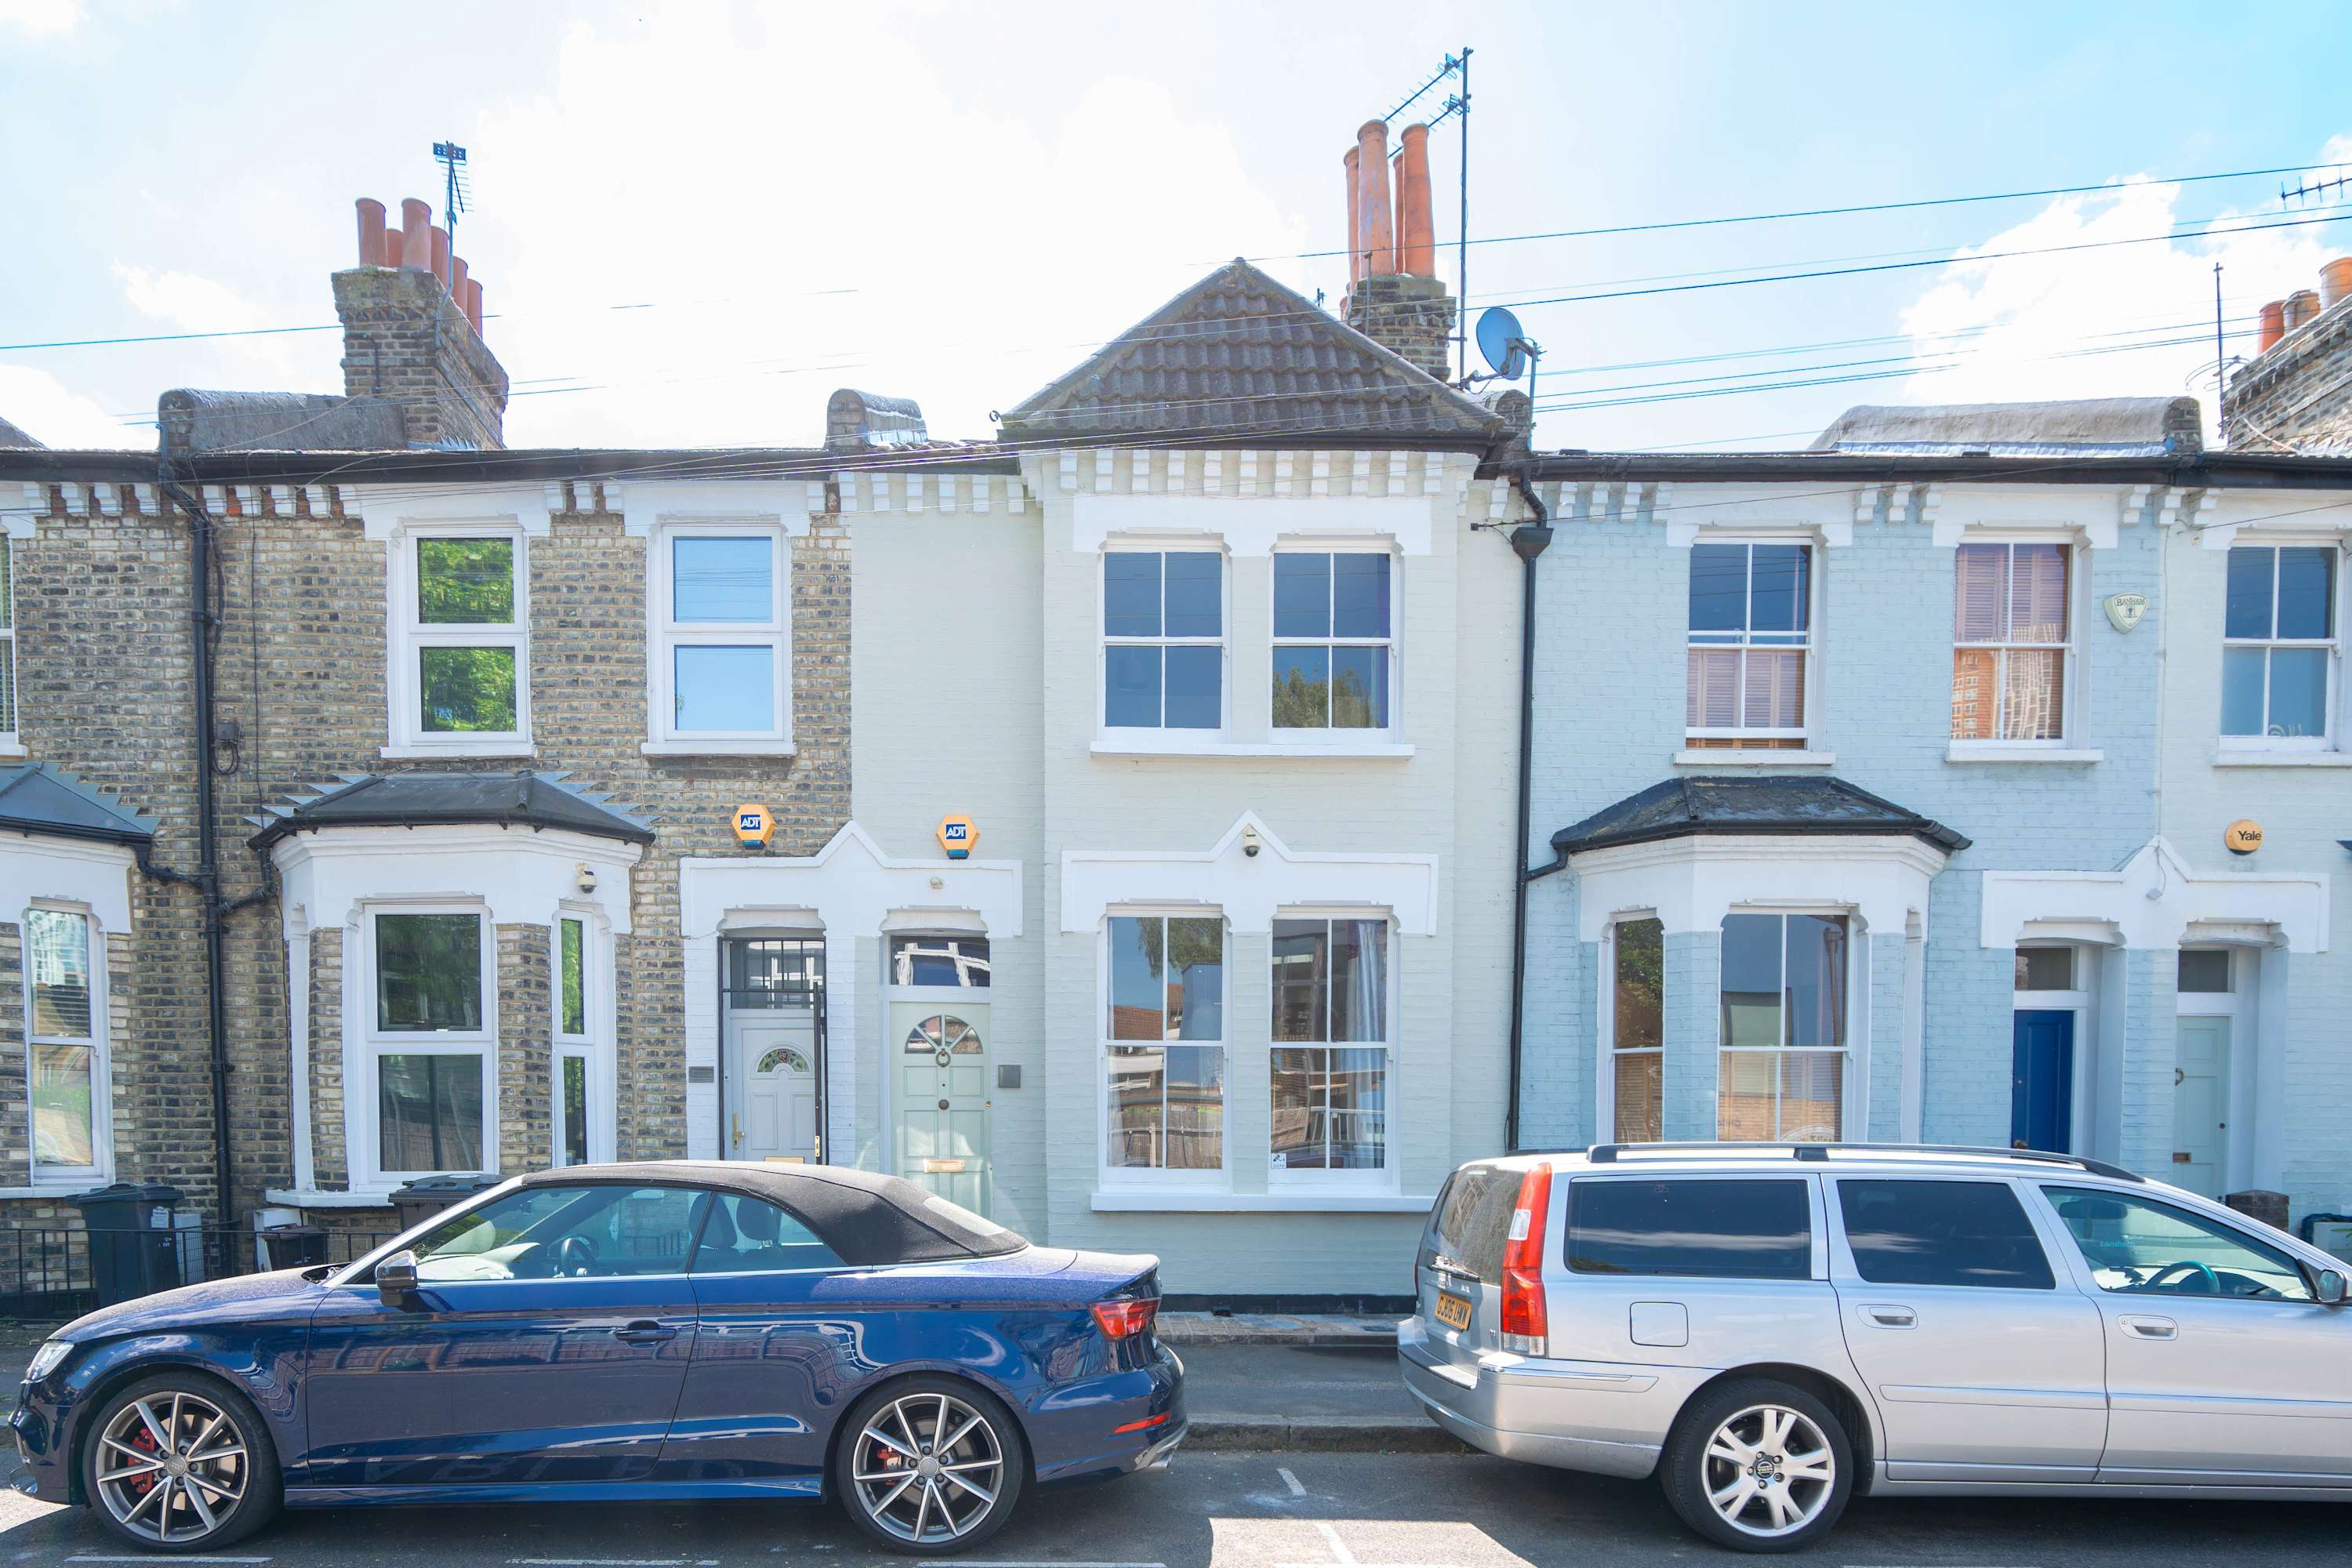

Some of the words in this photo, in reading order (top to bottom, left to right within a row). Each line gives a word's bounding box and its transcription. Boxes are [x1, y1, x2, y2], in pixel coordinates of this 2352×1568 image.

[2117, 597, 2146, 606] BANHAM
[740, 816, 761, 828] ADT
[946, 826, 967, 837] ADT
[2238, 830, 2262, 841] Yale
